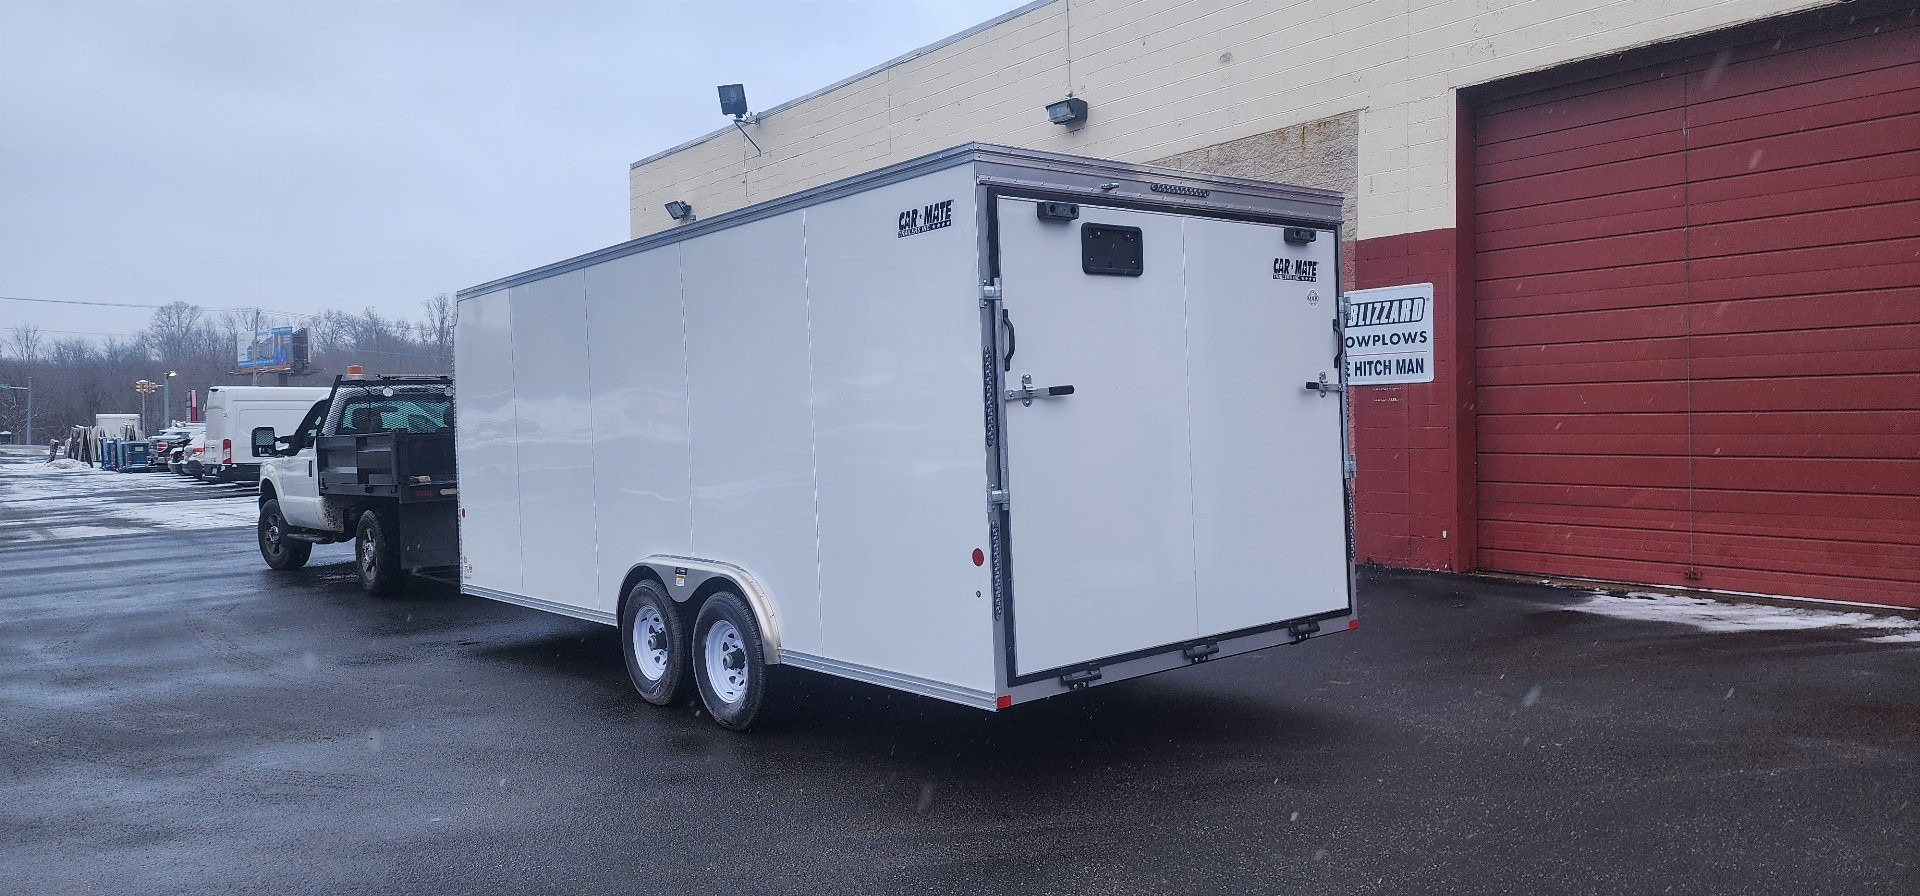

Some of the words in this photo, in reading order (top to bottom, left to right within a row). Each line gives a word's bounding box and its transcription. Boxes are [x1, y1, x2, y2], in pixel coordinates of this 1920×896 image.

[899, 208, 918, 231] CAR
[924, 199, 952, 225] MATE
[1273, 257, 1290, 275] CAR
[1295, 259, 1317, 277] MATE
[1347, 298, 1424, 327] BLIZZARD
[1345, 331, 1428, 349] OWPLOWS
[1354, 360, 1392, 377] HITCH
[1396, 358, 1424, 375] MAN
